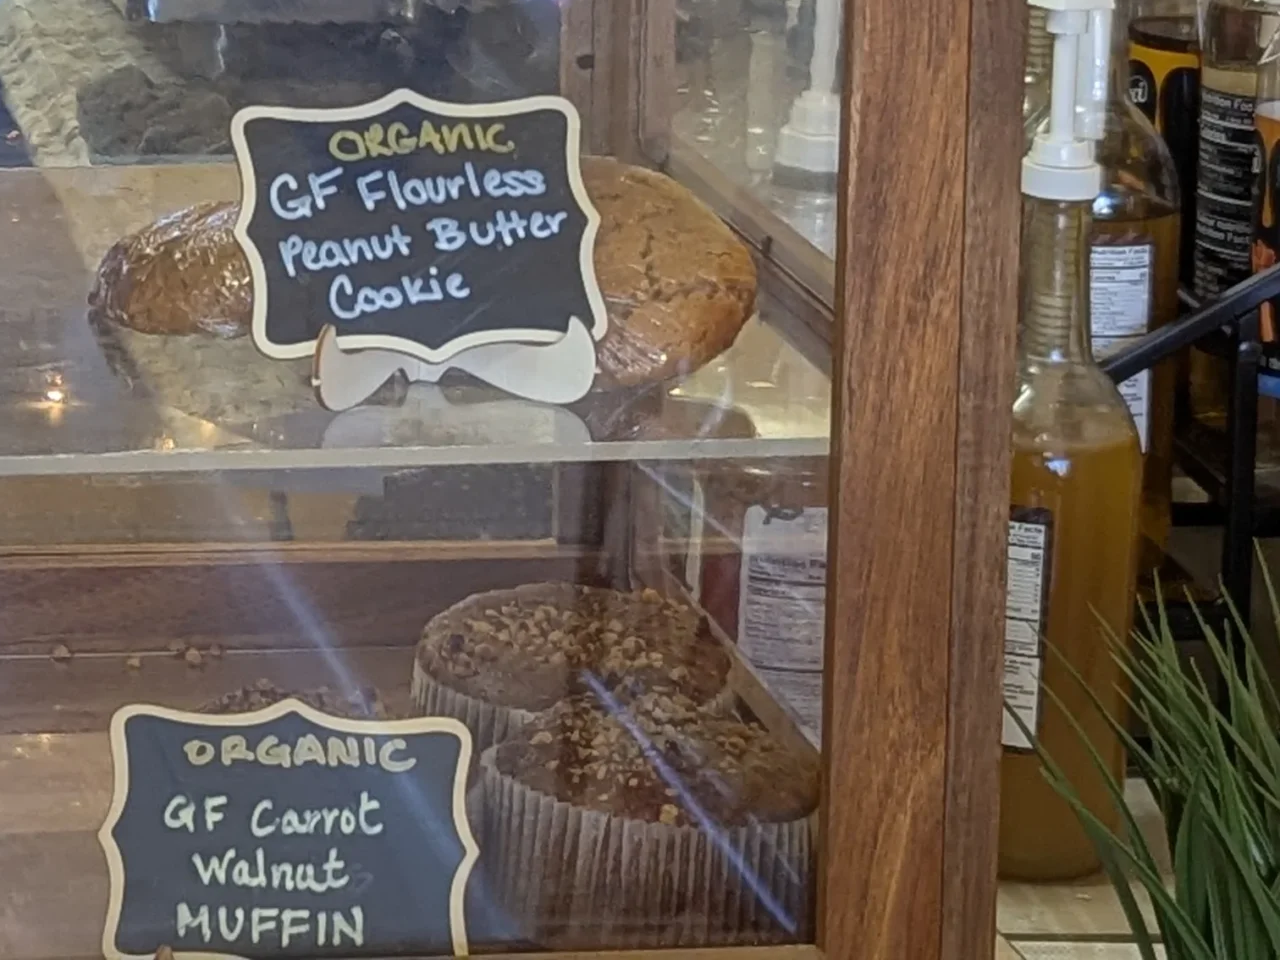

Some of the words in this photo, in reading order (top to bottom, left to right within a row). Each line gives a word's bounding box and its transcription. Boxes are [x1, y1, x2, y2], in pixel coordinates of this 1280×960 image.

[328, 120, 516, 162] ORGANIC
[270, 166, 345, 220] GF
[356, 161, 547, 211] Flourless
[426, 210, 568, 252] Butter
[328, 266, 471, 320] Cookie
[183, 733, 418, 773] ORGANIC
[164, 795, 228, 833] GF
[250, 791, 384, 838] Carrot
[191, 847, 350, 892] Walnut
[176, 902, 365, 948] MUFFIN
